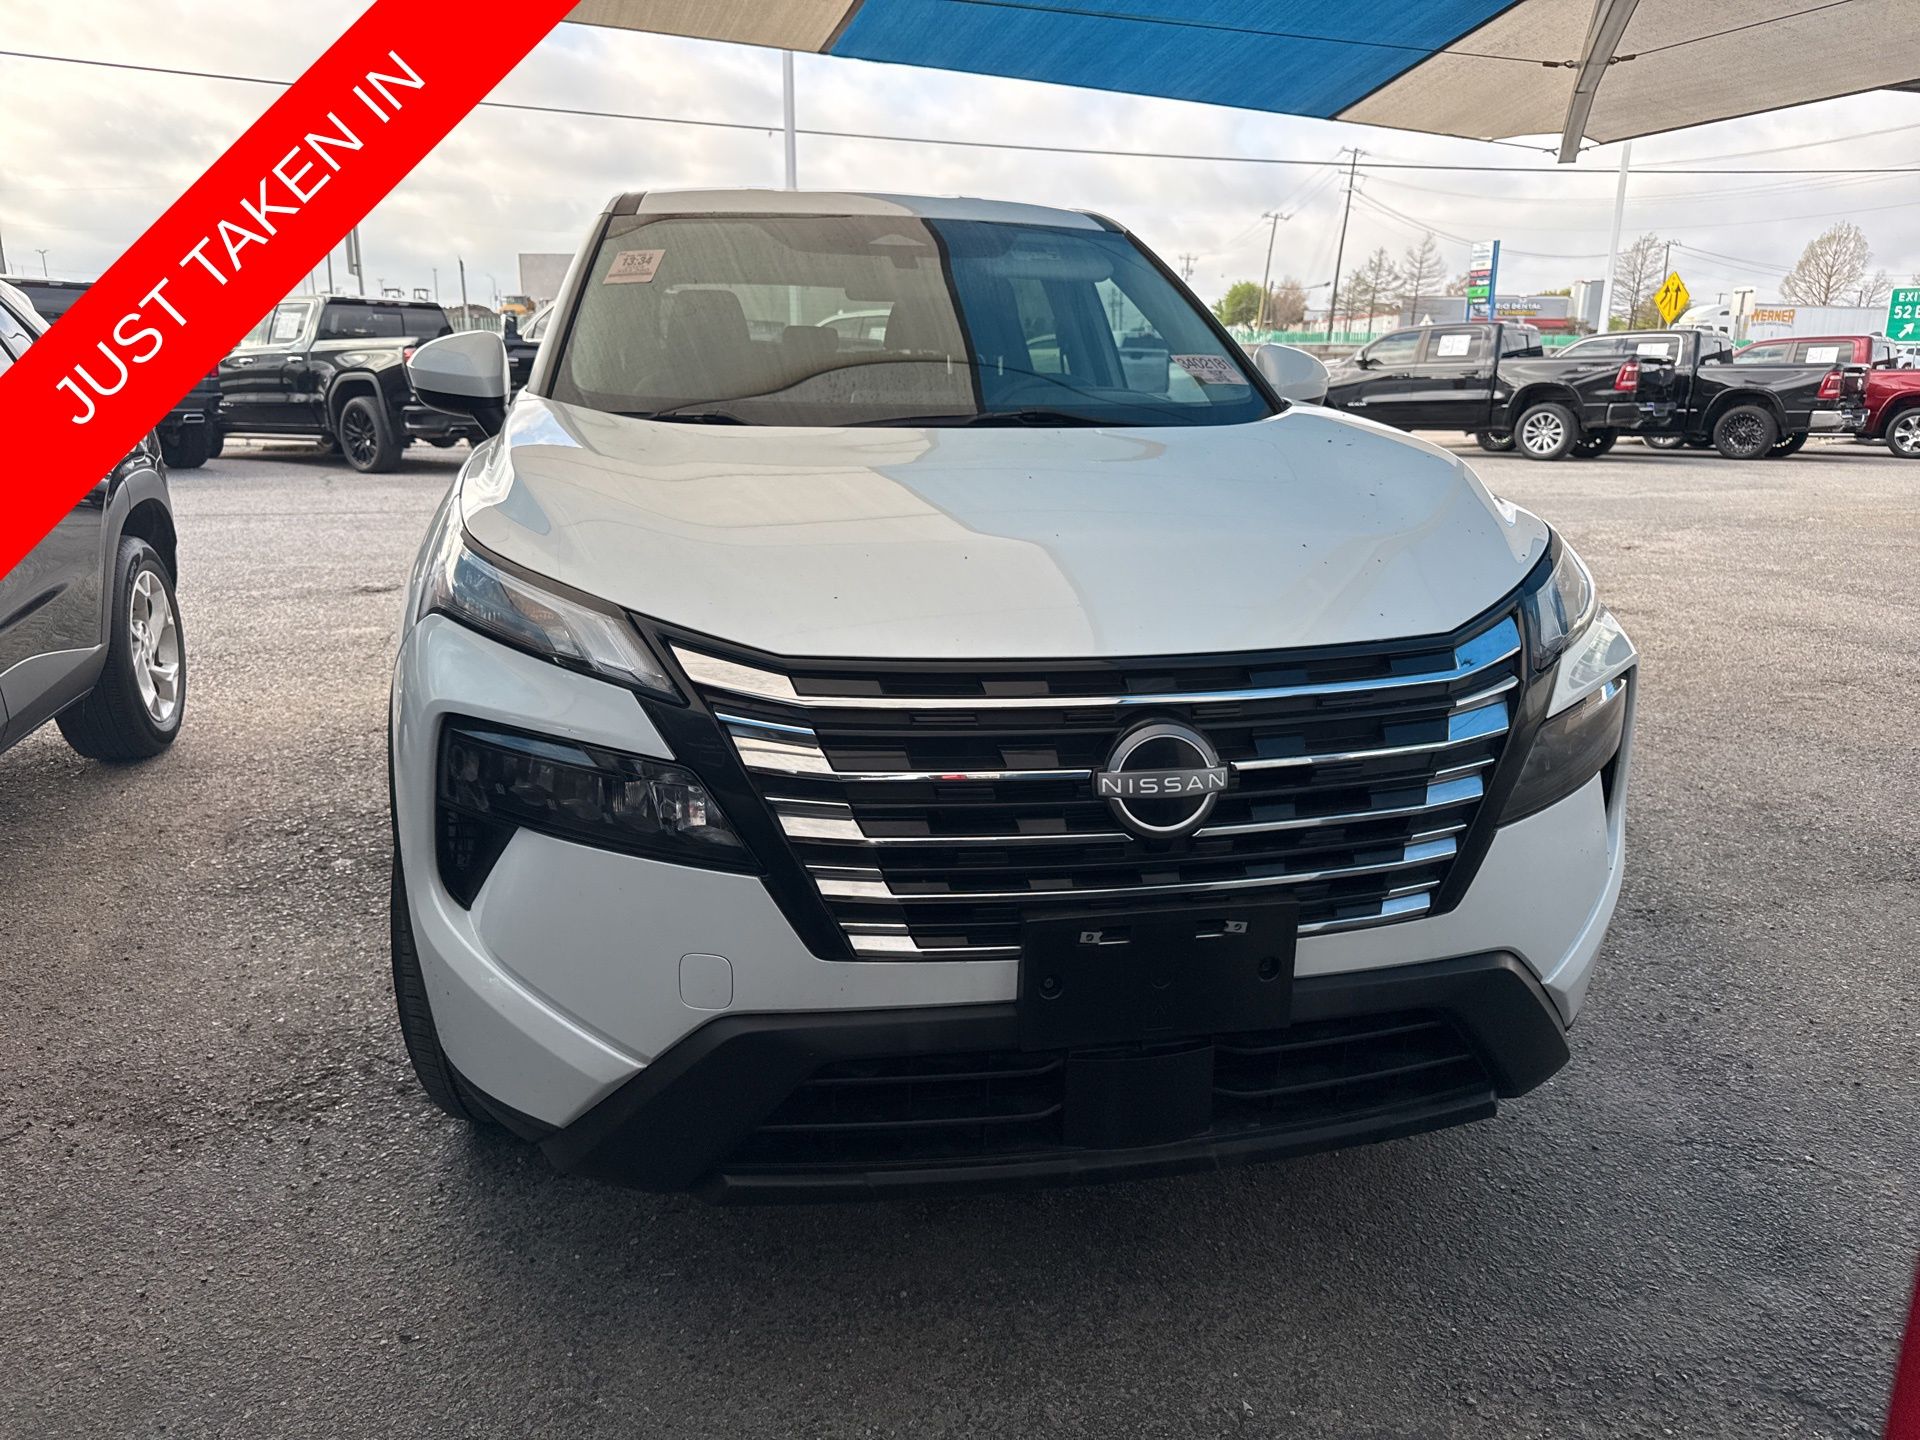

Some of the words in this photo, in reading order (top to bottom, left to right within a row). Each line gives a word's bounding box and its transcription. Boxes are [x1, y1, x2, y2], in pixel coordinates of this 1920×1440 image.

[1898, 292, 1920, 302] EXI
[1751, 309, 1795, 324] WERNER
[1894, 305, 1912, 319] 52
[1102, 772, 1225, 794] NISSAN
